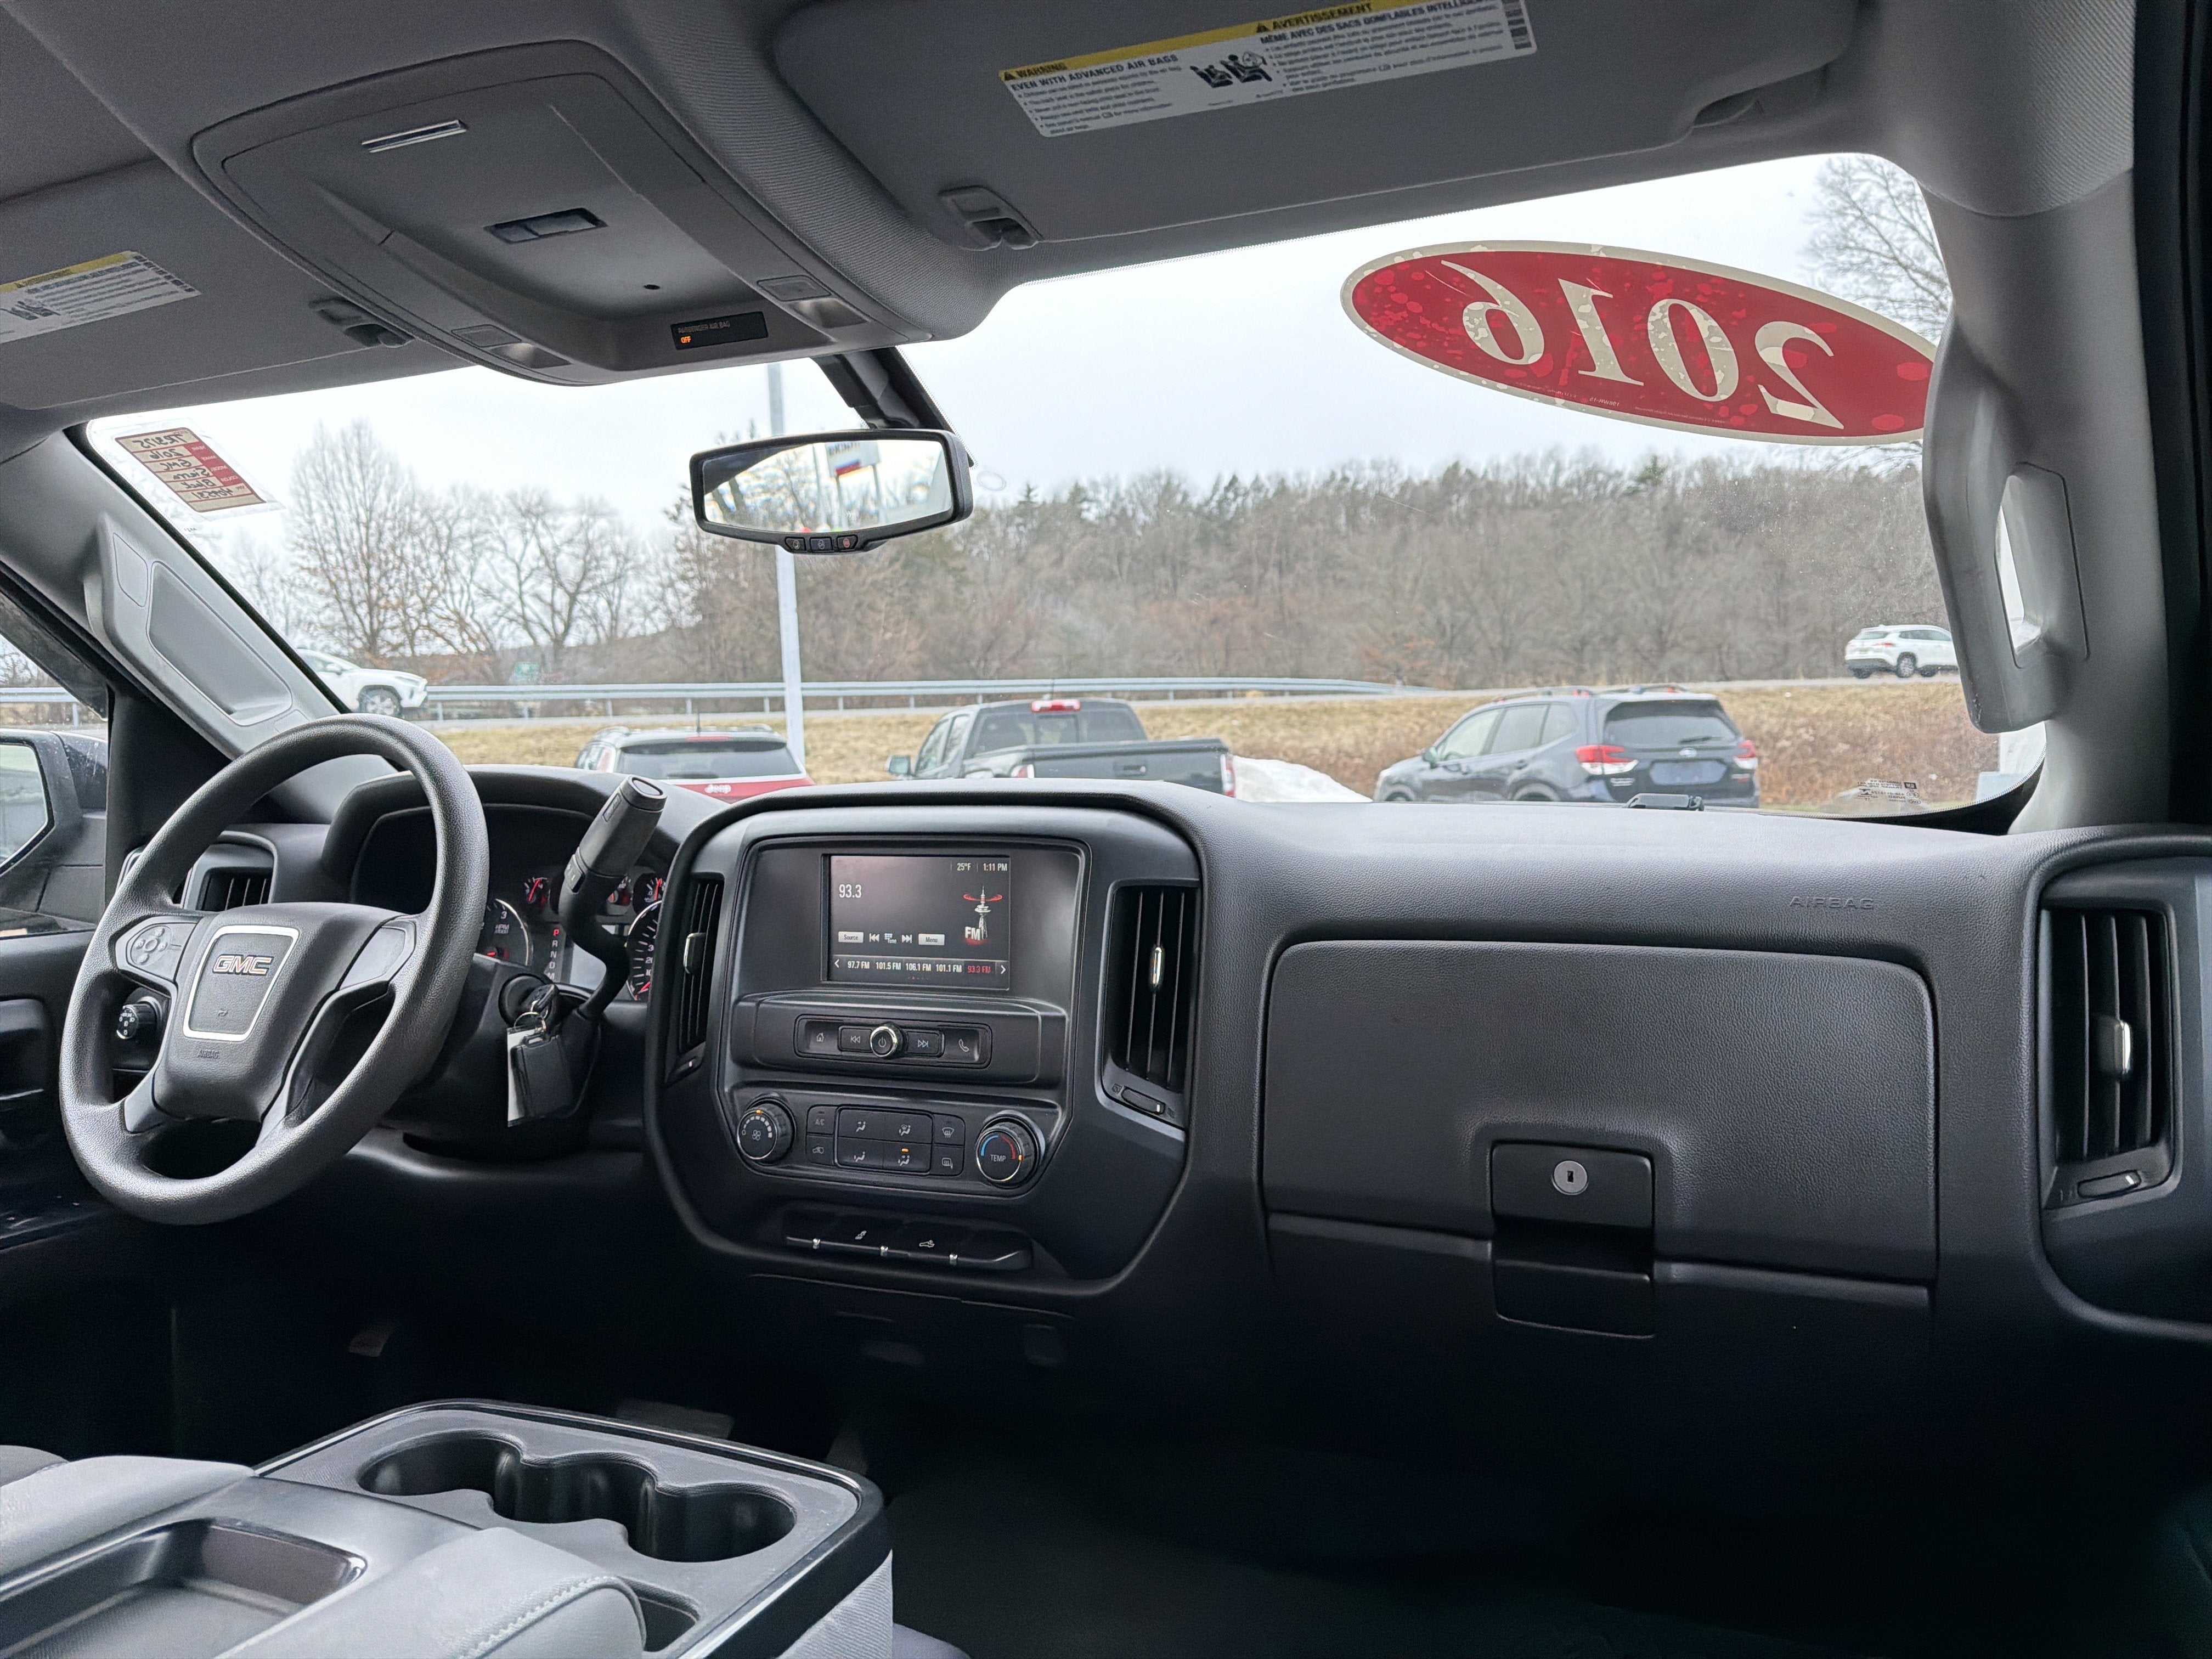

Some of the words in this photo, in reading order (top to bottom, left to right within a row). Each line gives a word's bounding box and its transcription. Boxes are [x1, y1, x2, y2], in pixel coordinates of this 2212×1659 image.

[1290, 27, 1314, 40] AVEC
[1011, 79, 1038, 91] EVEN
[1040, 75, 1067, 87] WITH
[1068, 64, 1125, 82] ADVANCED
[1127, 59, 1147, 70] AIR
[1148, 53, 1179, 66] BAGS
[1016, 62, 1068, 78] WARNING
[680, 336, 691, 344] OFF
[957, 862, 972, 871] 25°F
[983, 863, 995, 871] 1:11
[997, 863, 1008, 871] PM
[839, 884, 862, 898] 93.3
[1789, 896, 1874, 910] AIRBAG
[964, 926, 981, 940] FM
[212, 954, 274, 975] GMC
[847, 961, 861, 969] 97.7
[861, 961, 870, 969] FM
[876, 961, 891, 970] 101.5
[891, 962, 901, 970] FM
[905, 963, 921, 971] 106.1
[936, 964, 952, 972] 101.1
[952, 964, 962, 973] FM
[990, 1154, 1006, 1163] TEMP
